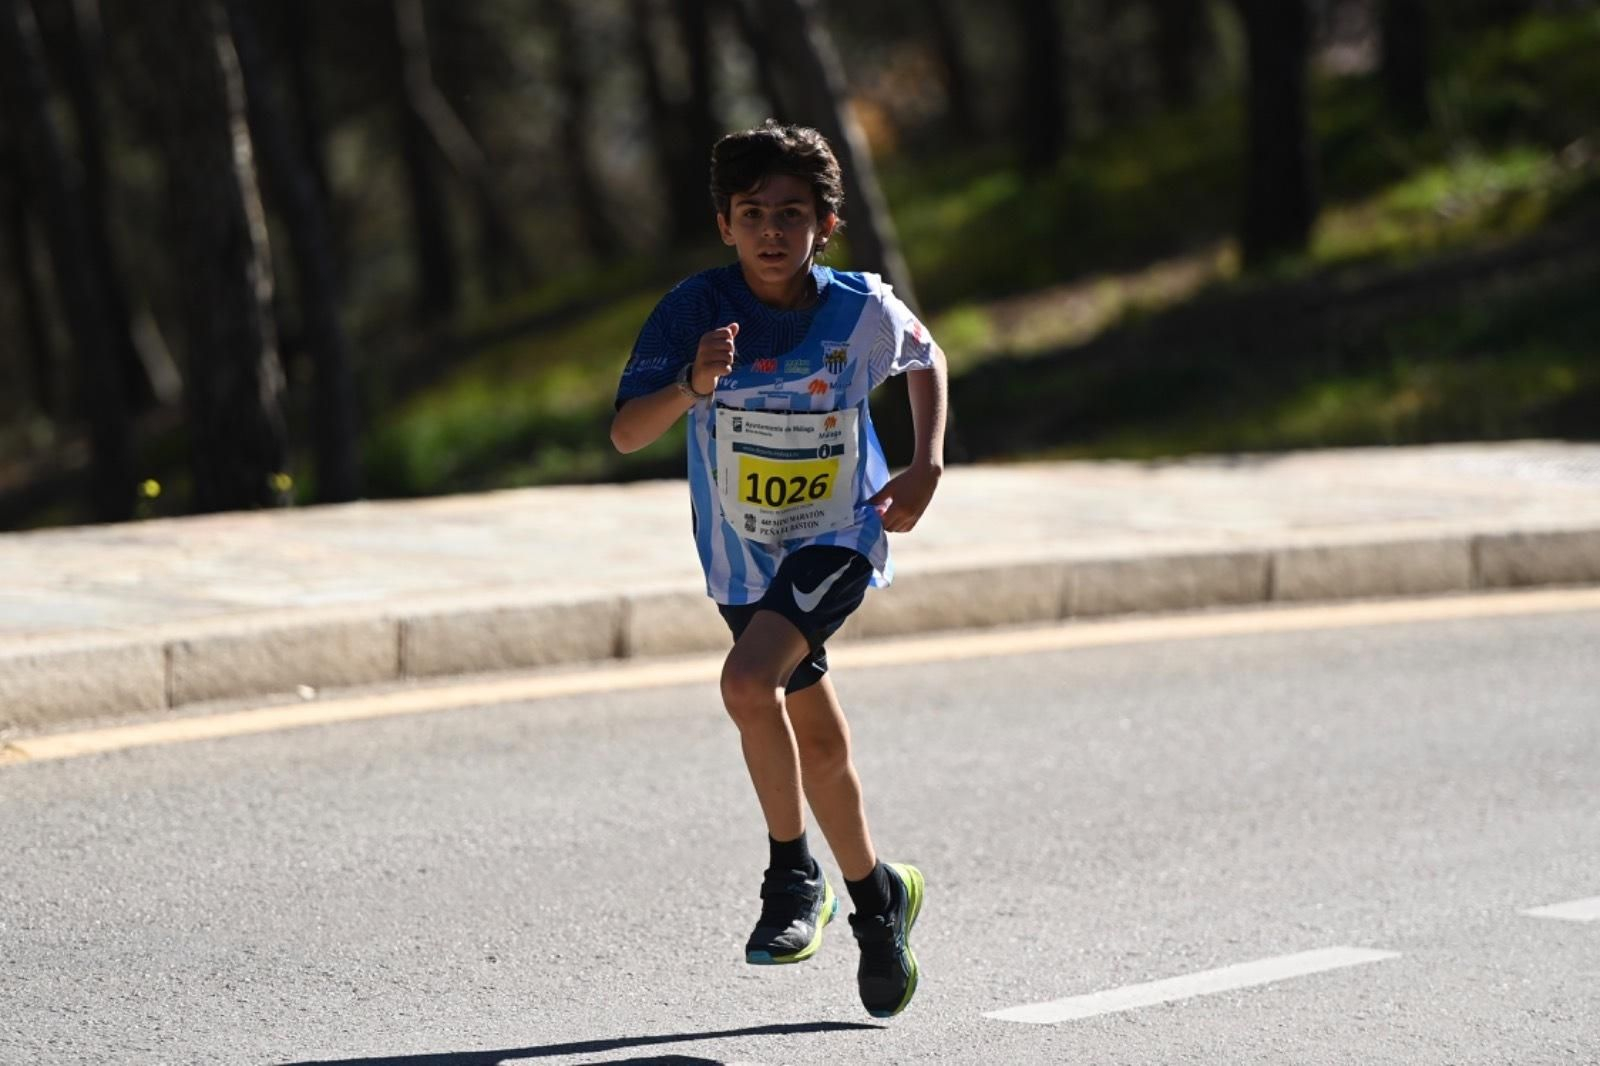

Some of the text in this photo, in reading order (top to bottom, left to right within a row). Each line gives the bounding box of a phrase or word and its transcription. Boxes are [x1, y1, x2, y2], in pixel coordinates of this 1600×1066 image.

[745, 421, 783, 432] Ayuntamiento
[793, 425, 815, 434] Málaga
[746, 472, 830, 507] 1026
